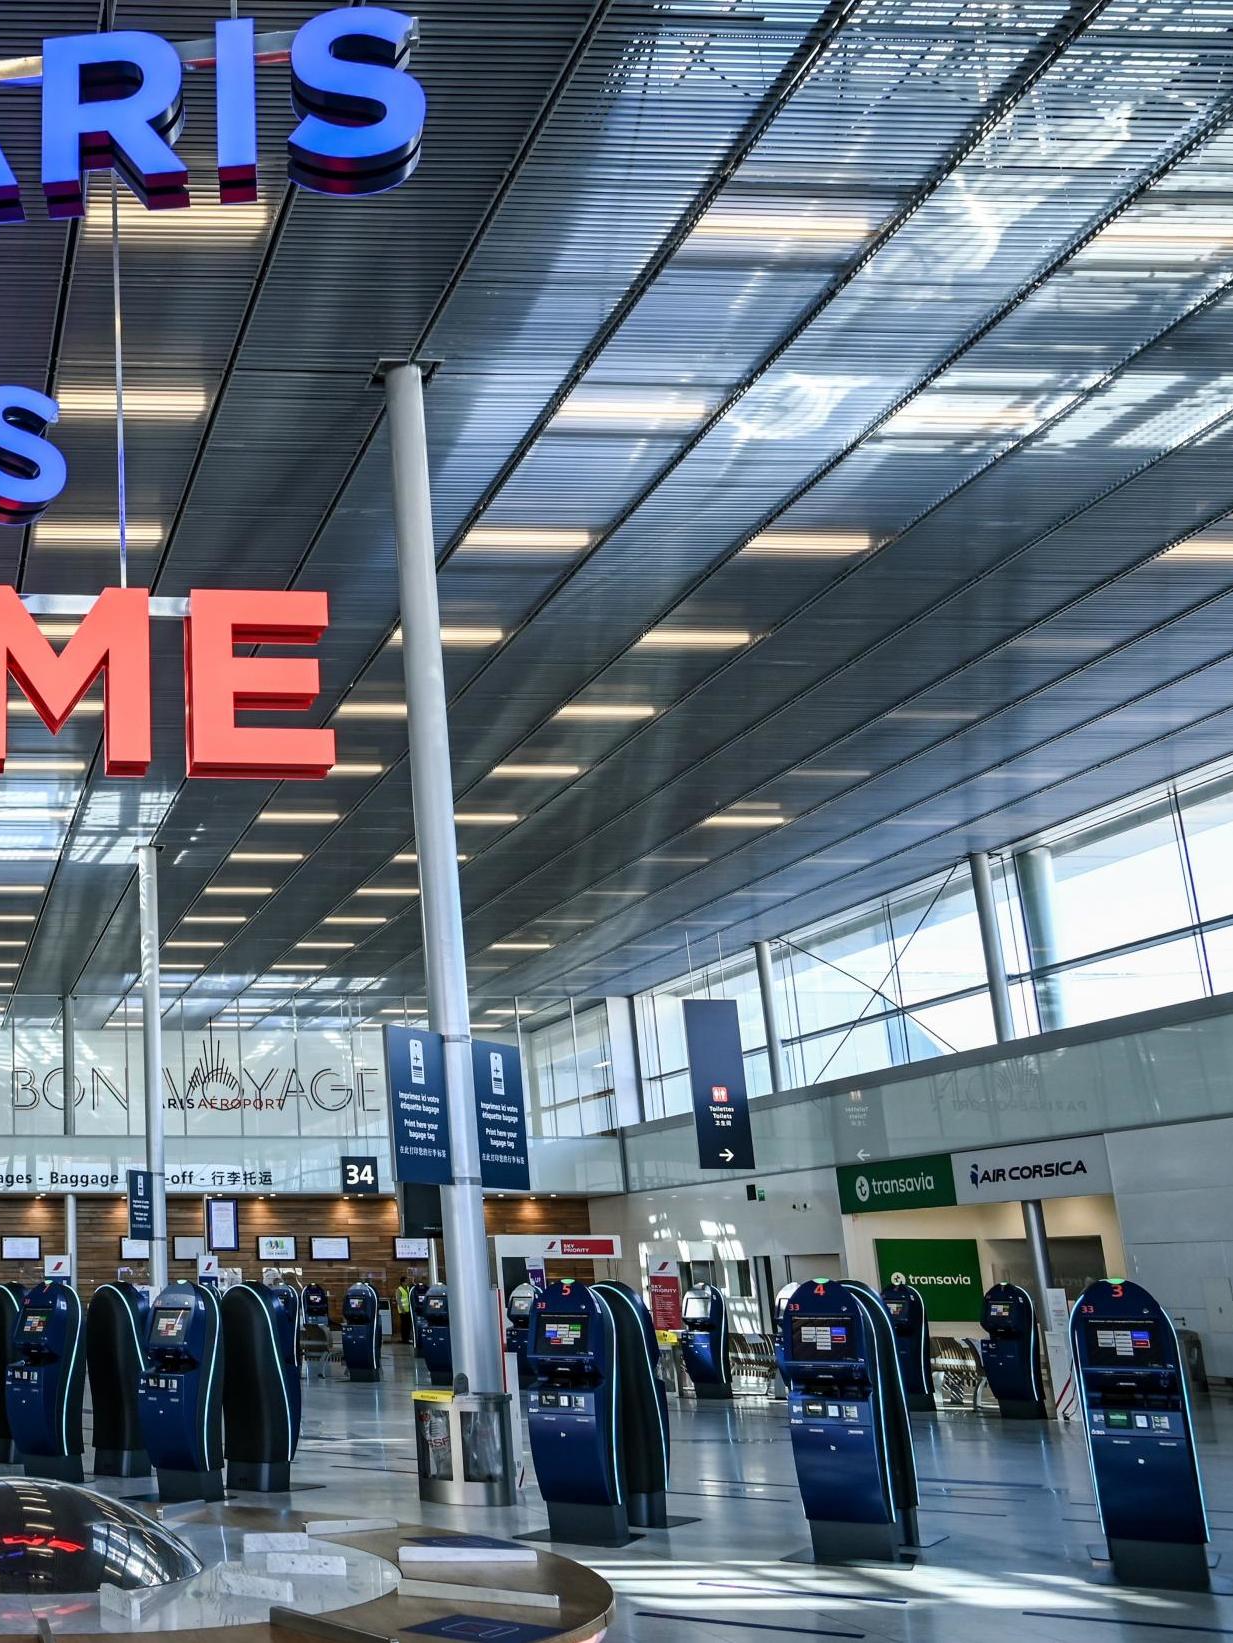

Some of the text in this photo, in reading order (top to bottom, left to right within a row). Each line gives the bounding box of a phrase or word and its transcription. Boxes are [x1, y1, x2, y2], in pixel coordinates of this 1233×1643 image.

[12, 1067, 130, 1111] BON
[398, 1090, 421, 1101] Imprimez
[427, 1095, 440, 1103] votre
[422, 1103, 440, 1115] bagage
[480, 1100, 501, 1111] Imprimez
[708, 1105, 735, 1113] Toilettes
[713, 1112, 732, 1120] Toilets
[404, 1118, 439, 1131] Print here your
[427, 1132, 435, 1141] tag
[485, 1127, 496, 1136] Print
[497, 1128, 507, 1137] here
[346, 1164, 374, 1185] 34
[979, 1159, 1088, 1184] AIR CORSICA
[50, 1171, 118, 1187] Baggage
[211, 1170, 273, 1186] 行李托运
[871, 1171, 935, 1195] transavia
[909, 1273, 971, 1286] transavia
[561, 1284, 572, 1296] 5
[814, 1284, 825, 1296] 4
[1111, 1284, 1124, 1298] 3
[536, 1302, 547, 1310] 33
[788, 1303, 800, 1311] 33
[1080, 1305, 1094, 1314] 33
